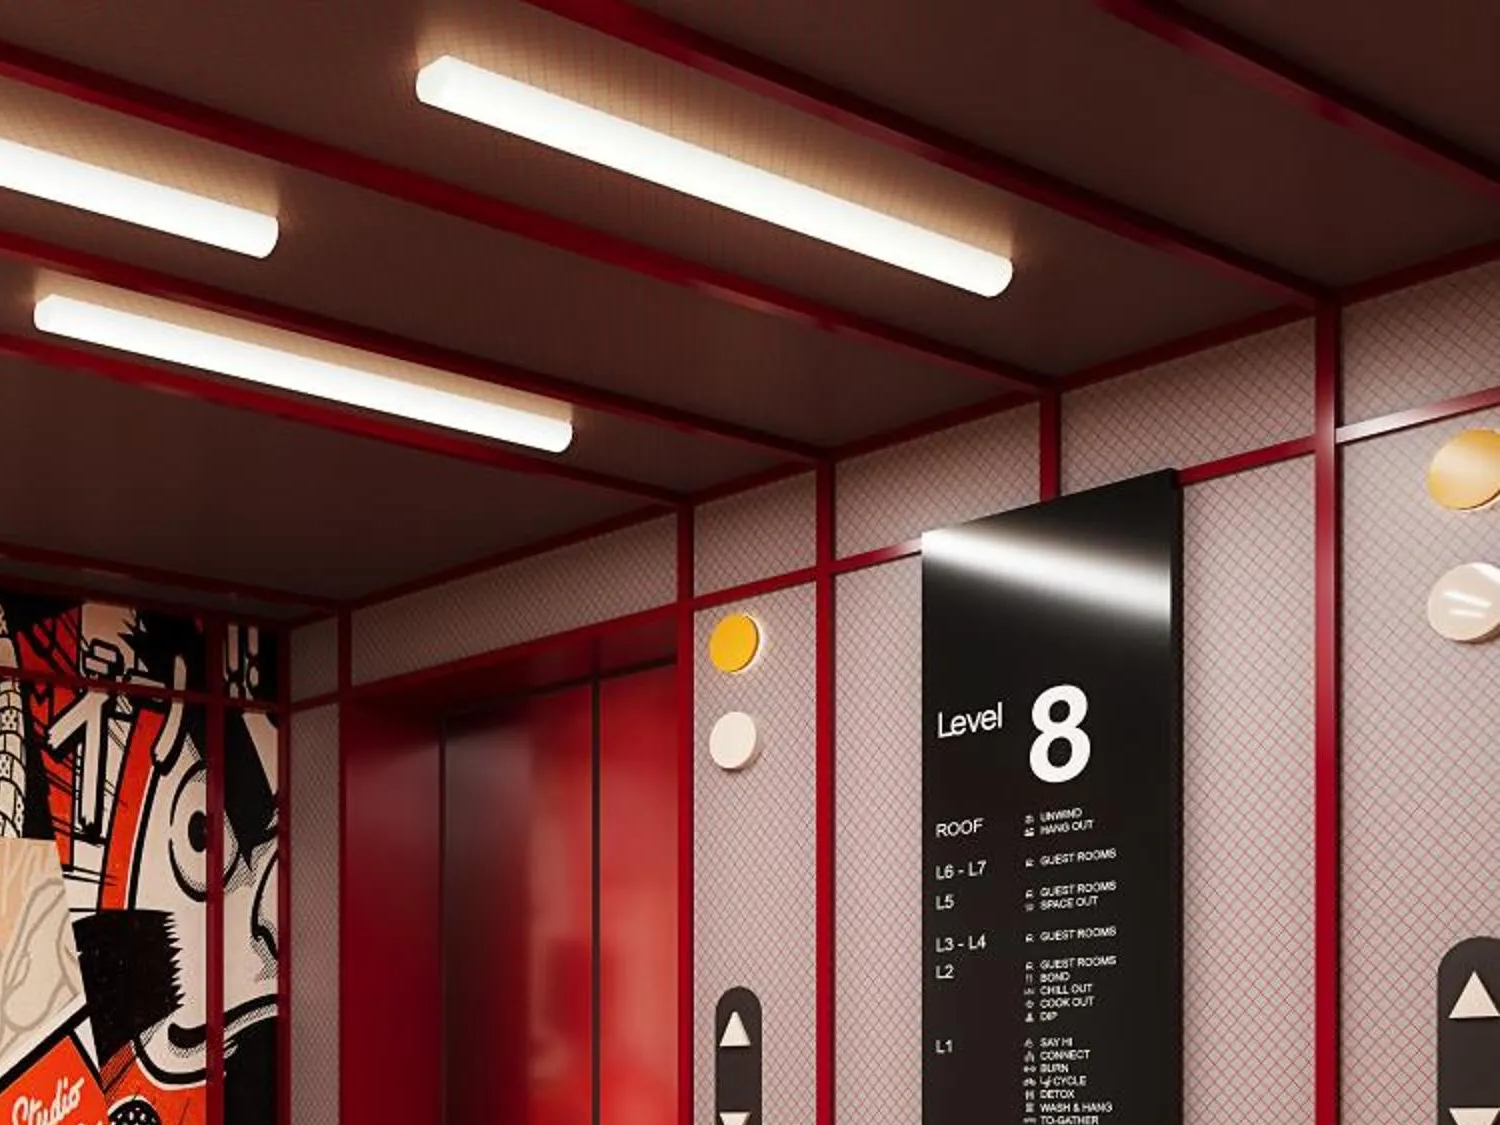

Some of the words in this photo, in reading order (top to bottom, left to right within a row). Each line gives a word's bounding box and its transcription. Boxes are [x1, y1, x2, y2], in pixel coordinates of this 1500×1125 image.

[937, 701, 1004, 739] Level
[1029, 684, 1092, 784] 8
[1040, 807, 1083, 822] UNWIND
[935, 817, 985, 838] ROOF
[1040, 822, 1071, 835] HANG
[1072, 819, 1095, 831] OUT
[1040, 852, 1075, 866] GUEST
[1077, 847, 1117, 862] ROOMS
[935, 863, 955, 880] L6
[968, 859, 988, 877] L7
[1040, 884, 1075, 897] GUEST
[1077, 880, 1117, 894] ROOMS
[935, 894, 955, 910] L5
[1040, 897, 1075, 911] SPACE
[1076, 895, 1099, 907] OUT
[1040, 929, 1076, 942] GUEST
[1077, 925, 1117, 939] ROOMS
[935, 937, 955, 953] L3
[967, 933, 987, 951] L4
[935, 963, 955, 979] L2
[1040, 957, 1076, 971] GUEST
[1077, 955, 1117, 968] ROOMS
[1040, 985, 1070, 996] CHILL
[1071, 983, 1093, 995] OUT
[1040, 997, 1071, 1009] COOK
[1071, 995, 1095, 1007] OUT
[935, 1039, 953, 1054] L1
[1040, 1037, 1060, 1047] SAY
[1061, 1037, 1073, 1047] HI
[1040, 1049, 1091, 1061] CONNECT
[1053, 1075, 1087, 1087] CYCLE
[1040, 1089, 1075, 1099] DETOX
[1040, 1101, 1071, 1113] WASH
[1081, 1101, 1113, 1113] HANG
